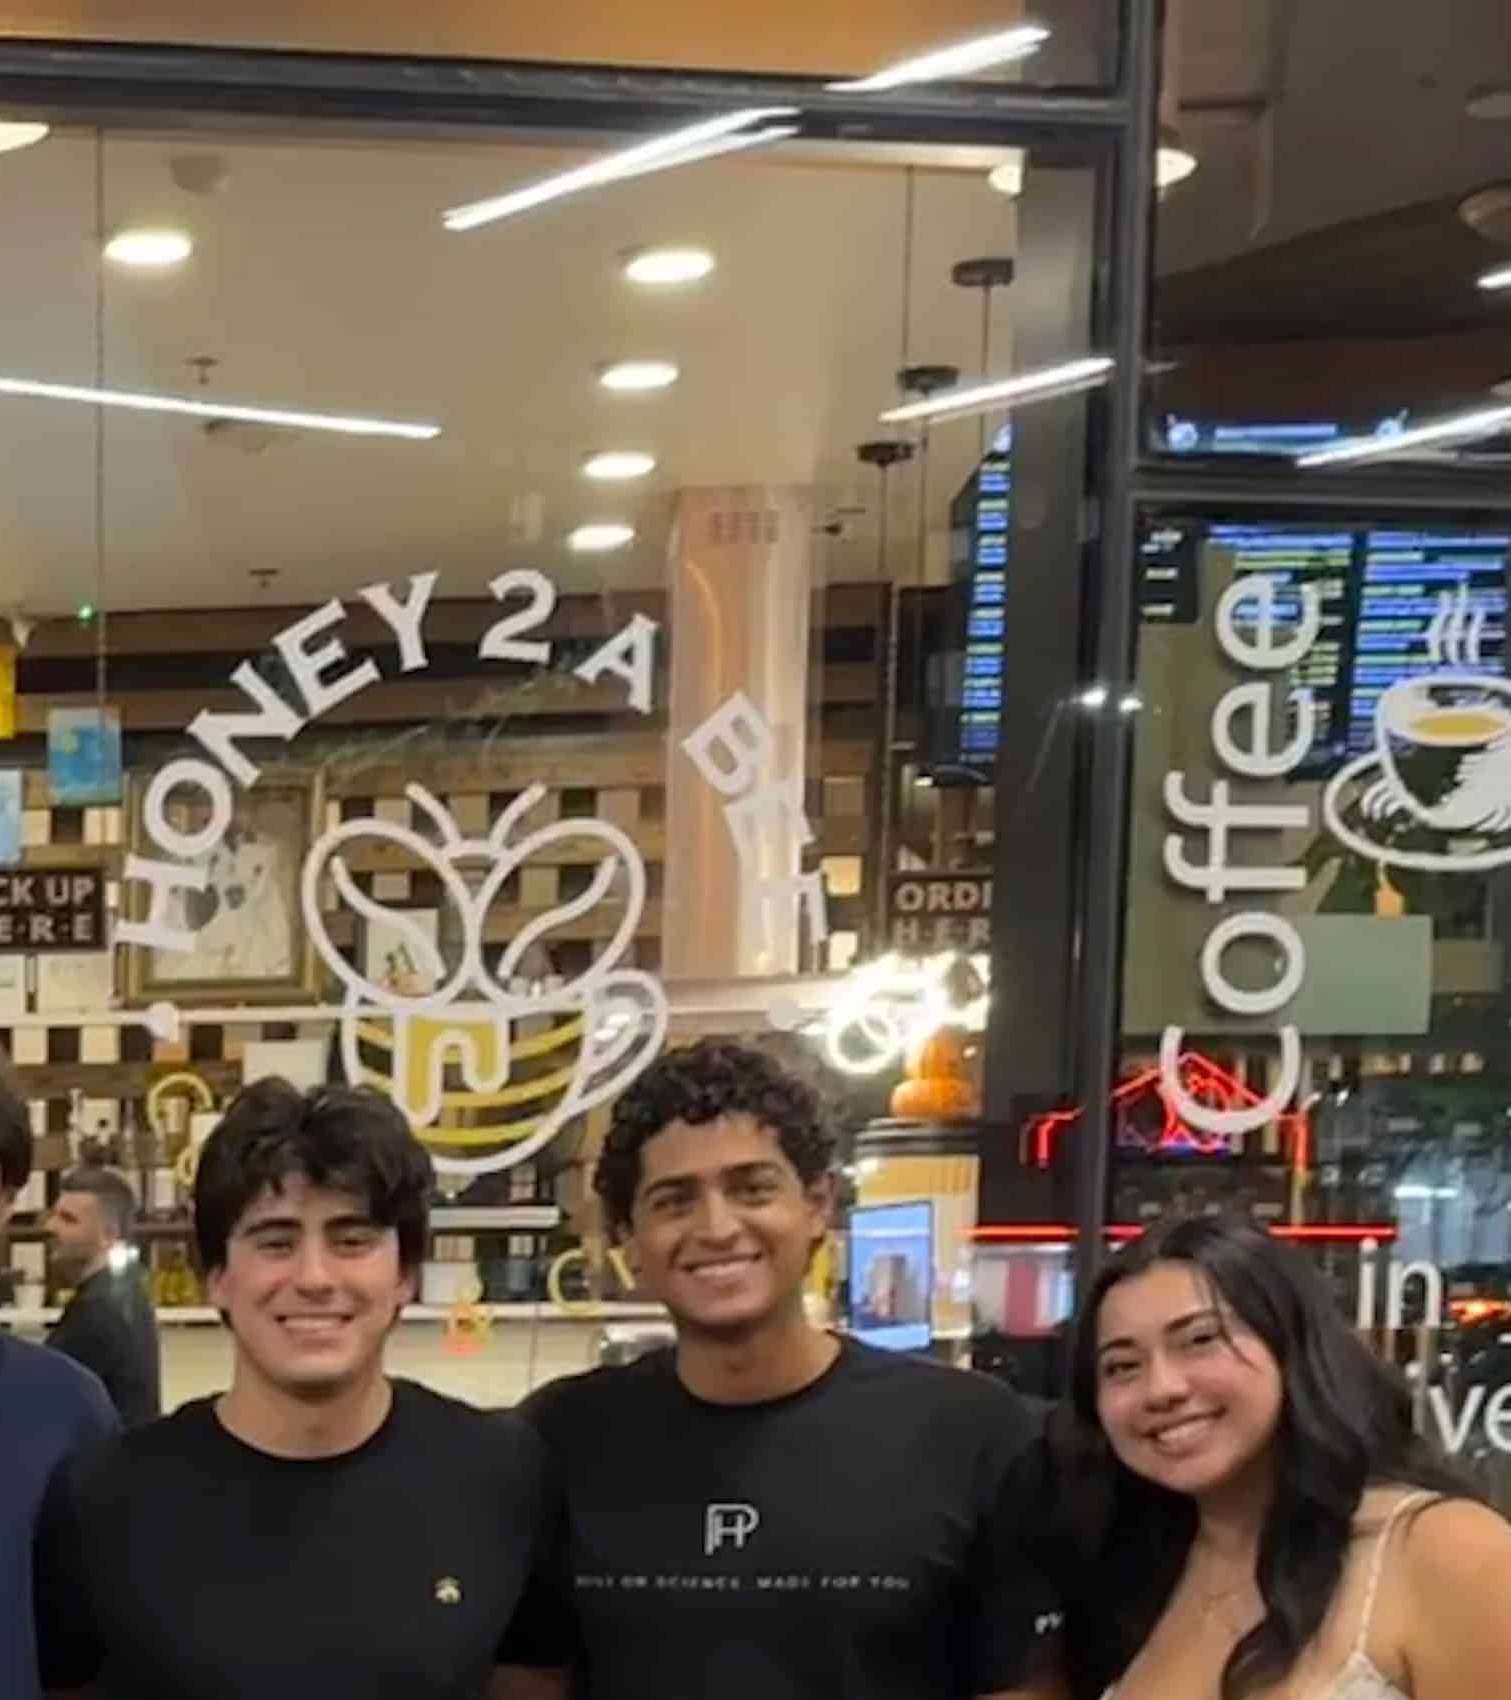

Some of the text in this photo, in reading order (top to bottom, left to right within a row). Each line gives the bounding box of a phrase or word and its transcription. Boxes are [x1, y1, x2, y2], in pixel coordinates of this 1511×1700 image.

[115, 570, 441, 952] HONEY
[480, 568, 557, 662] 2
[579, 612, 661, 714] A
[1159, 573, 1321, 1134] Coffee
[46, 877, 95, 903] UP
[1357, 1237, 1443, 1329] in
